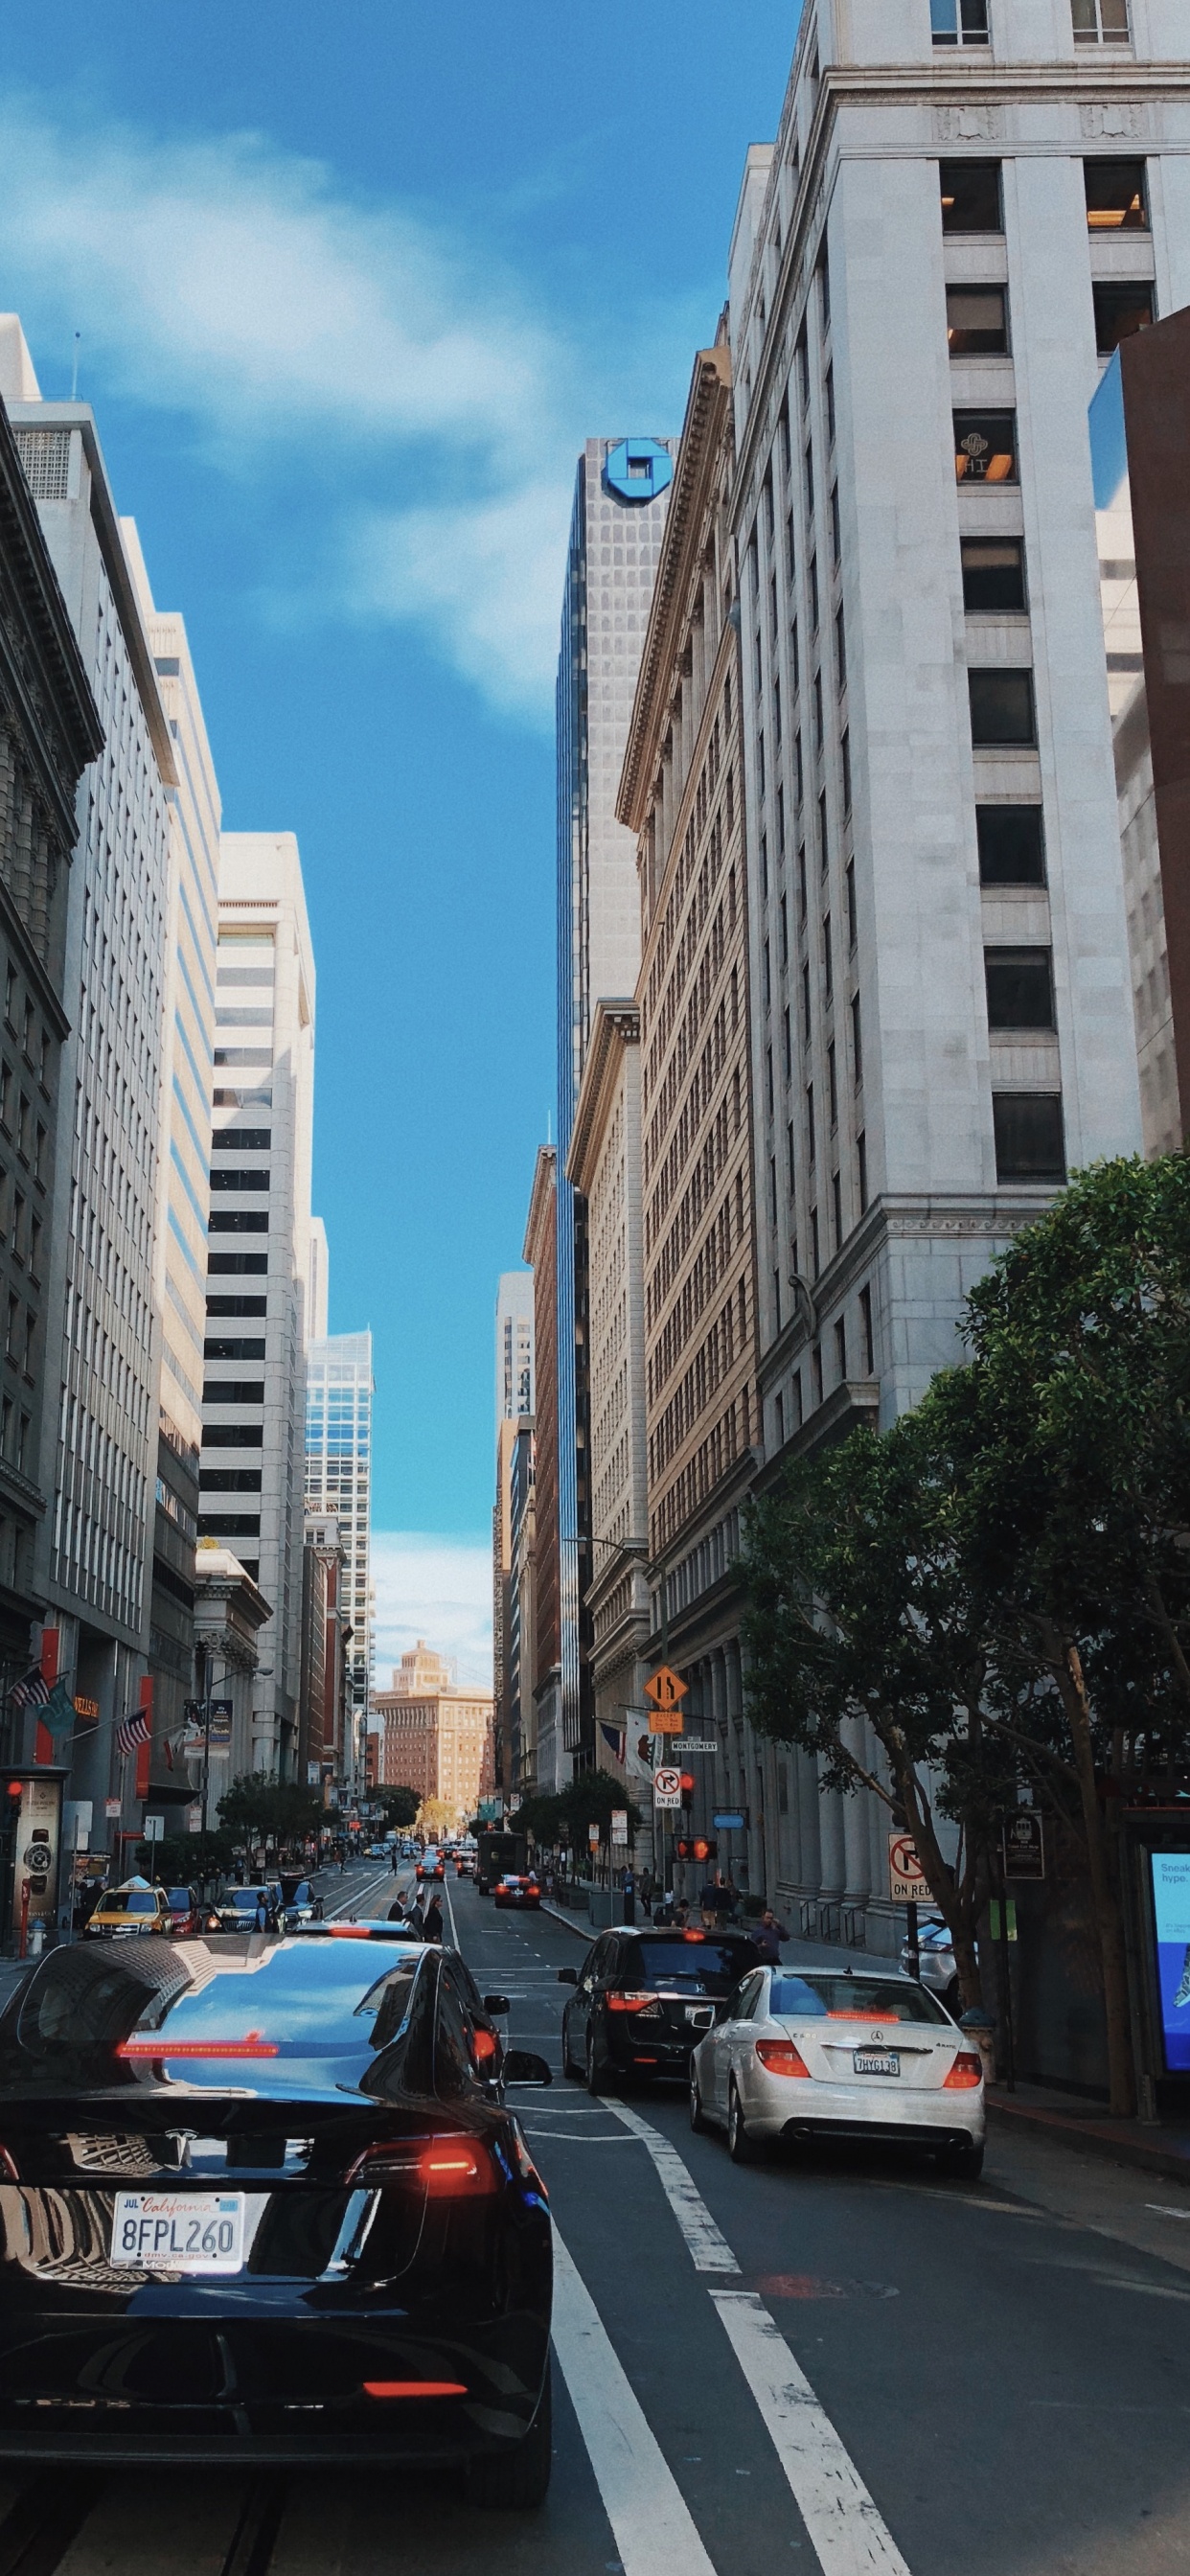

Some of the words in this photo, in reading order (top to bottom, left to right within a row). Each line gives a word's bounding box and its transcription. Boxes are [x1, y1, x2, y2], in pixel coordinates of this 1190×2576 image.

[1162, 1874, 1188, 1884] hype.
[894, 1884, 908, 1895] ON
[911, 1885, 931, 1896] RED
[858, 2058, 897, 2072] 7HYG138
[124, 2198, 139, 2208] JUL
[142, 2196, 211, 2218] California
[122, 2219, 233, 2252] 8FPL260
